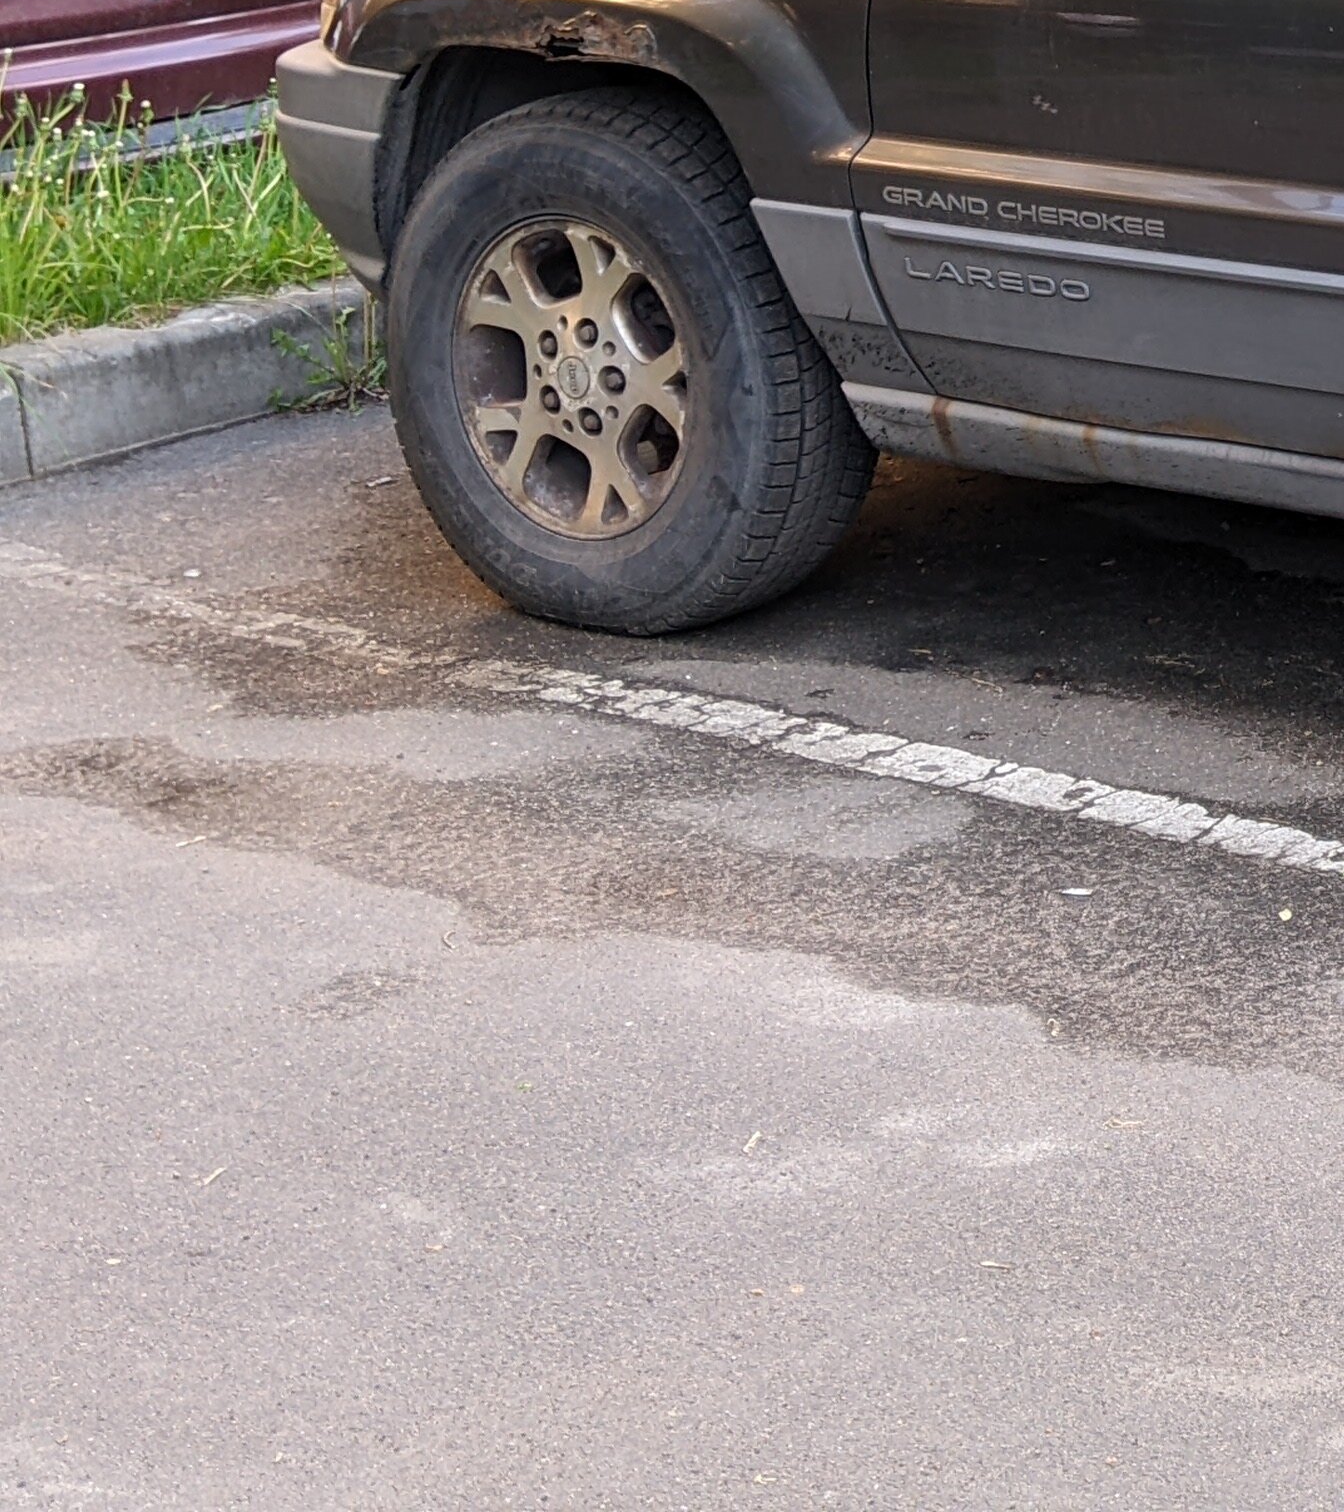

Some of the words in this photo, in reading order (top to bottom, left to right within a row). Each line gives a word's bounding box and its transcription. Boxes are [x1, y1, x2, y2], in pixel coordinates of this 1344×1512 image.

[882, 185, 988, 216] GRAND
[997, 201, 1166, 239] CHEROKEE
[904, 256, 1091, 302] LAREDO
